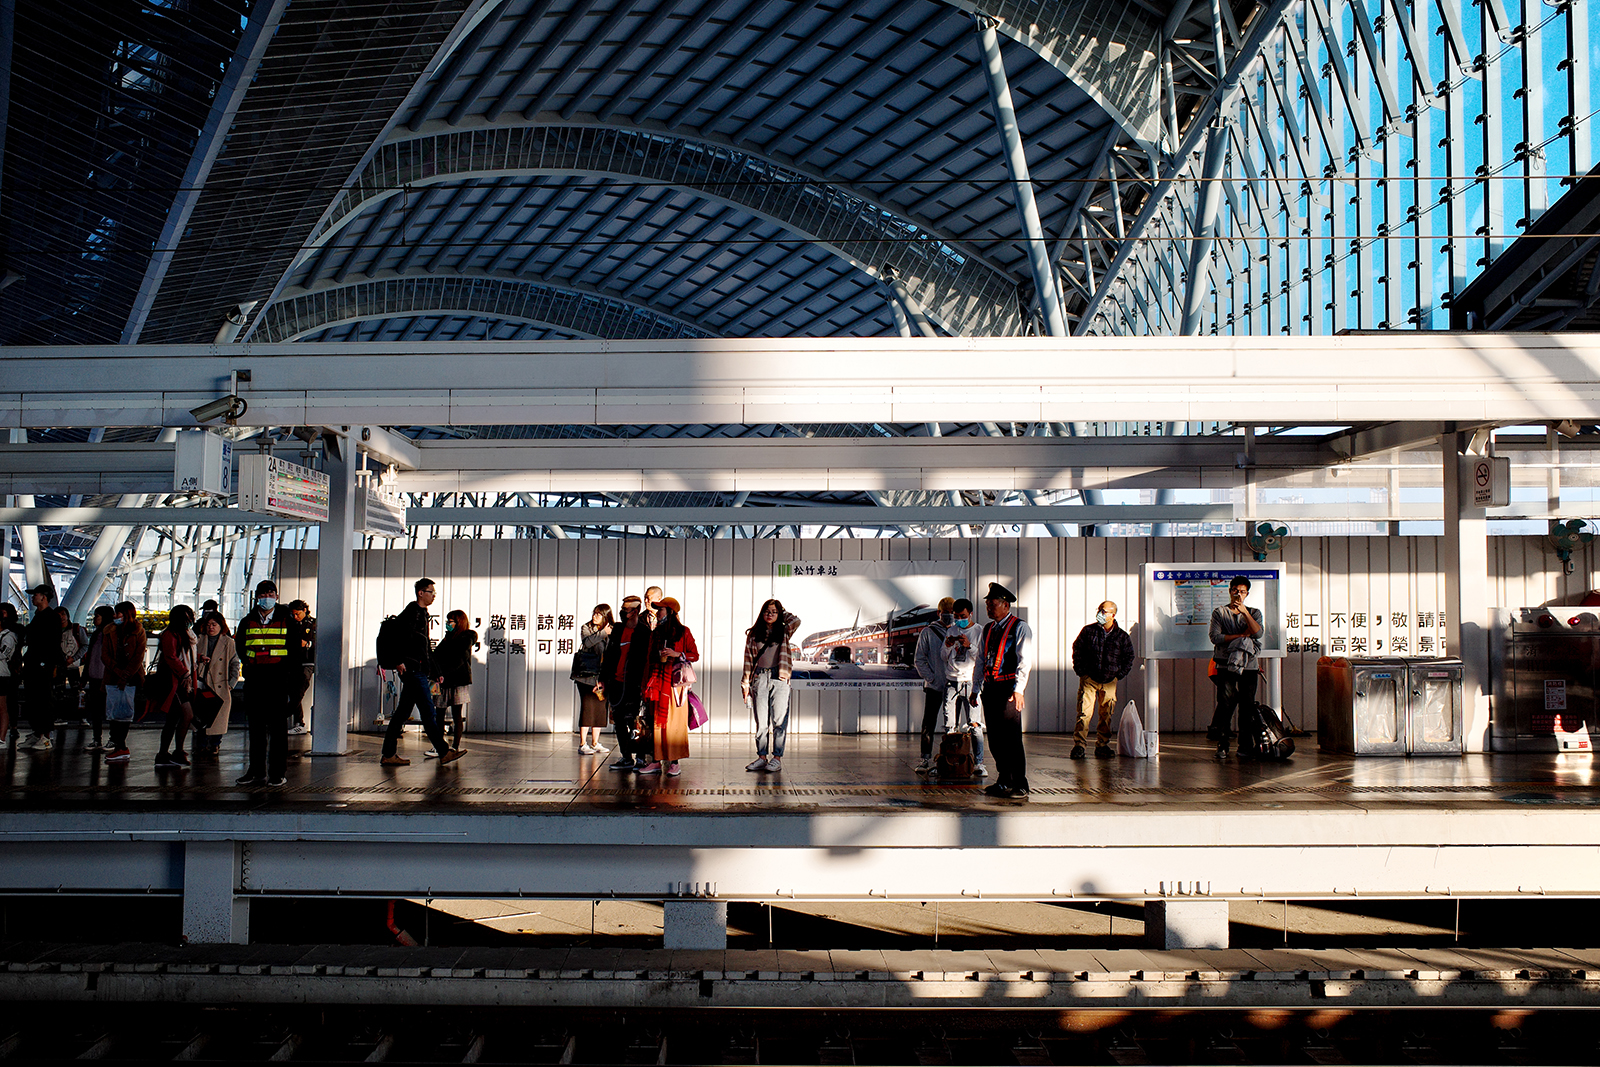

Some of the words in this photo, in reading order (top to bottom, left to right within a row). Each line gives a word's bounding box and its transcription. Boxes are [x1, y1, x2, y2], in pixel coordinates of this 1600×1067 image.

[268, 456, 277, 473] 2A
[222, 466, 229, 489] 8
[794, 565, 838, 576] 松竹車站
